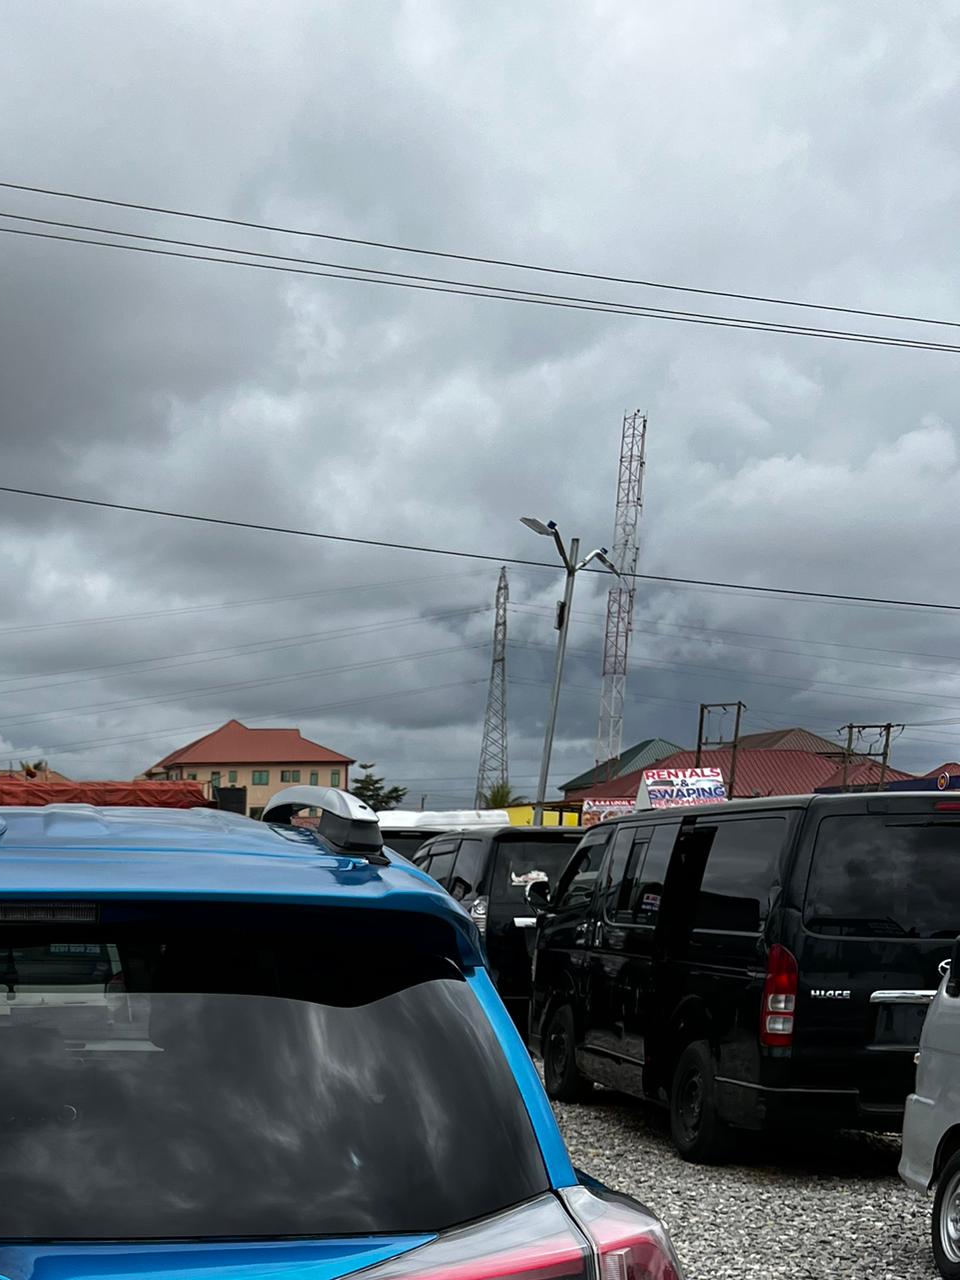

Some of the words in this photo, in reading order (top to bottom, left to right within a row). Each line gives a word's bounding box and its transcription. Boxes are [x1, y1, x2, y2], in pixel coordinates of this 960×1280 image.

[644, 767, 721, 780] RENTALS
[648, 786, 726, 800] SWAPING
[810, 989, 851, 999] HIACE
